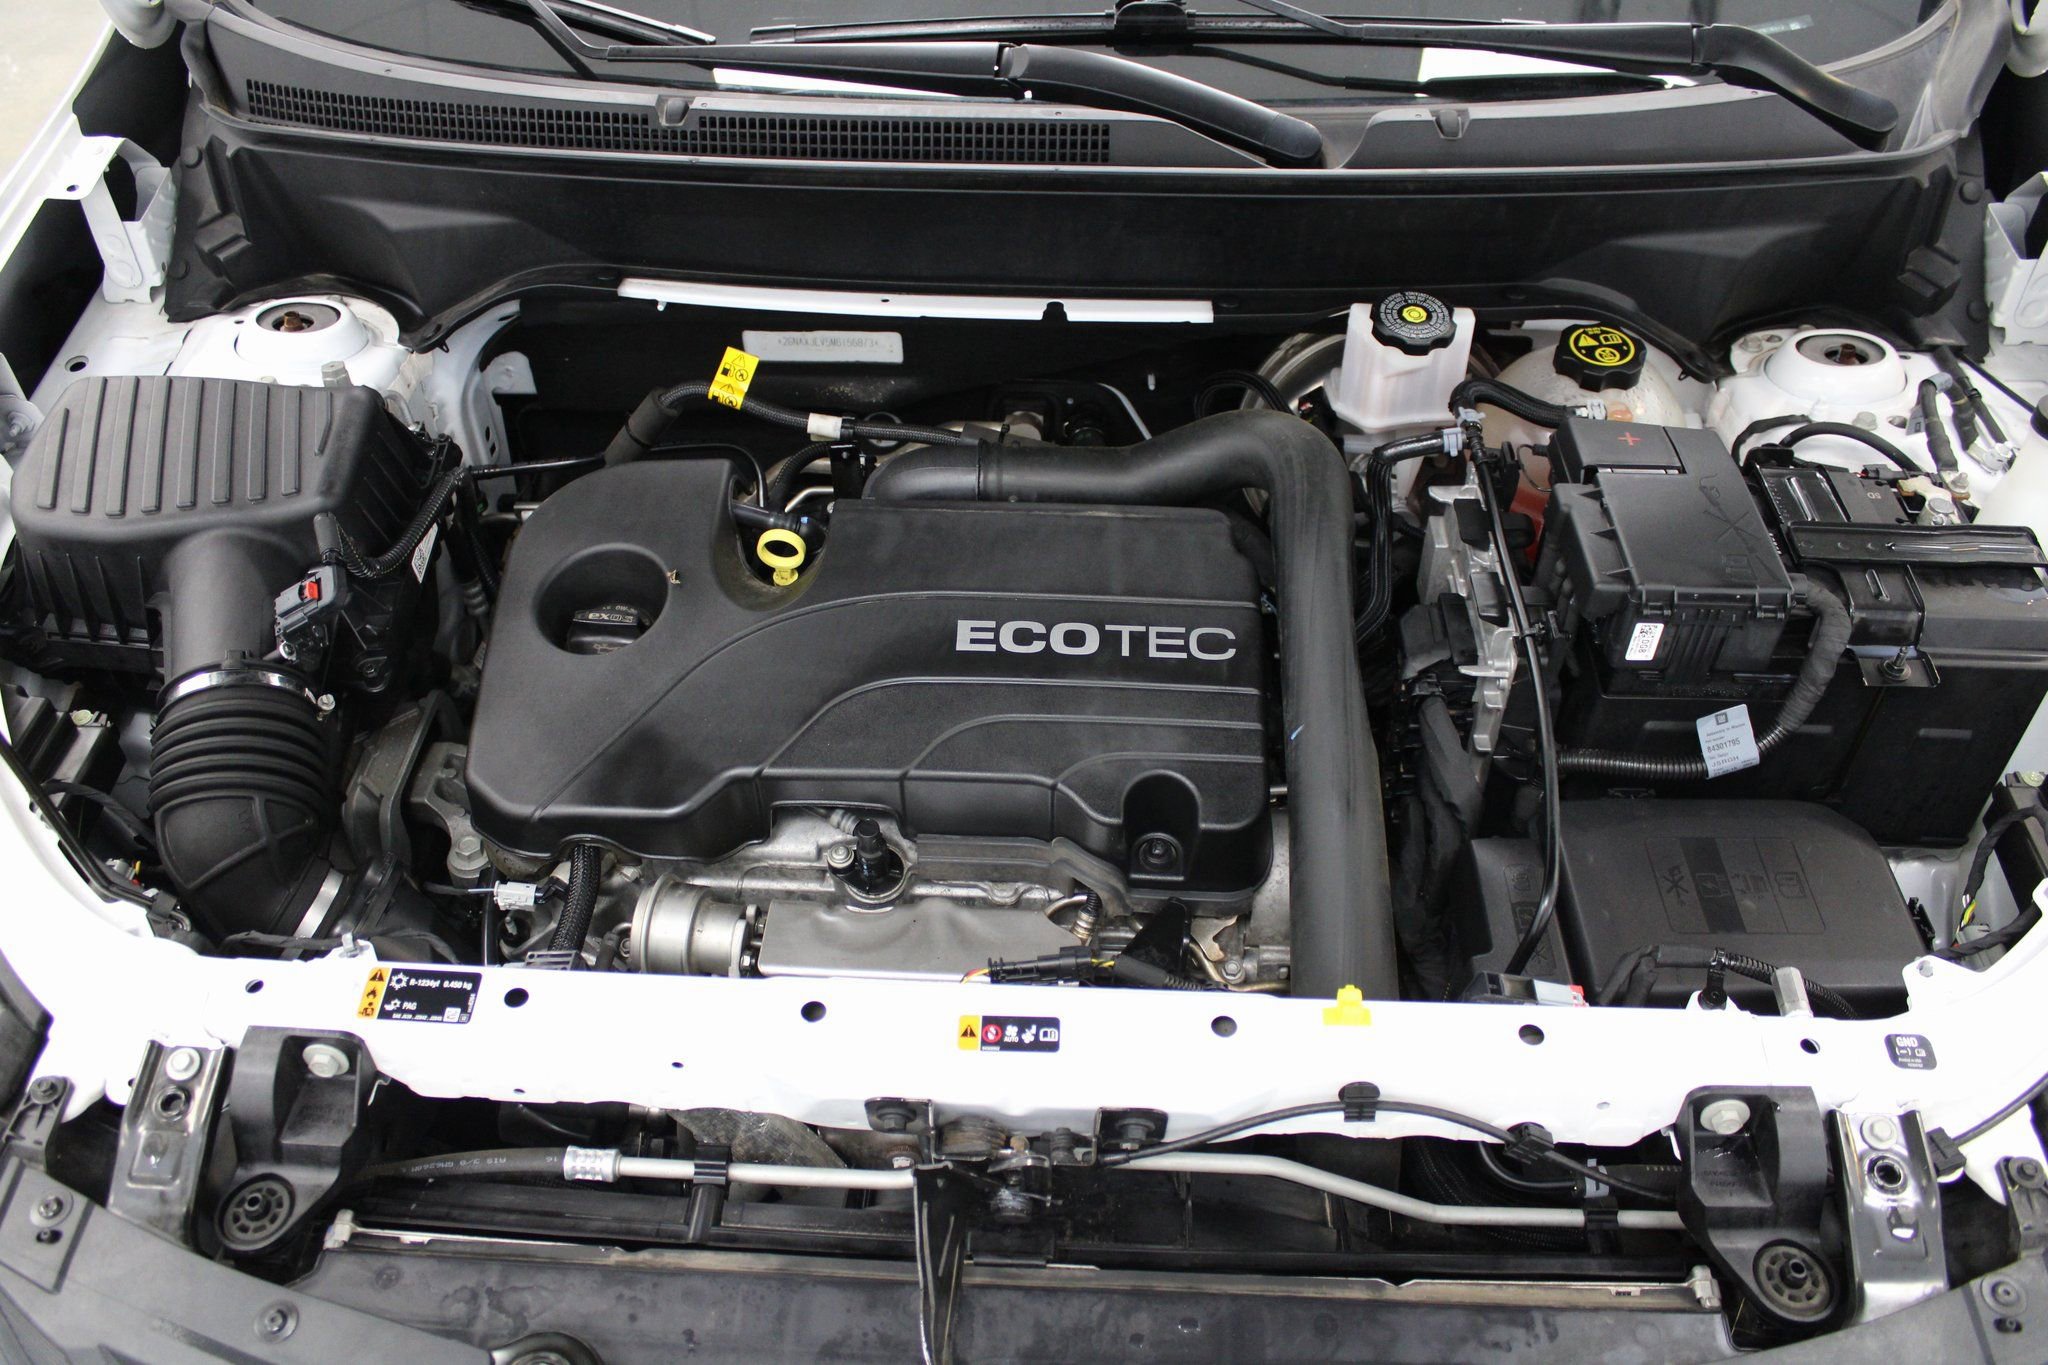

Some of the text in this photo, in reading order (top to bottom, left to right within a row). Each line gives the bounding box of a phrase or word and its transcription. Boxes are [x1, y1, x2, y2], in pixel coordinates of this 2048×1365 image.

[956, 619, 1236, 661] ECOTEC
[1707, 737, 1741, 753] 84301795
[409, 978, 473, 990] R-1234yf 0.450 kg
[402, 1001, 418, 1010] PAG
[1895, 1036, 1918, 1048] GND
